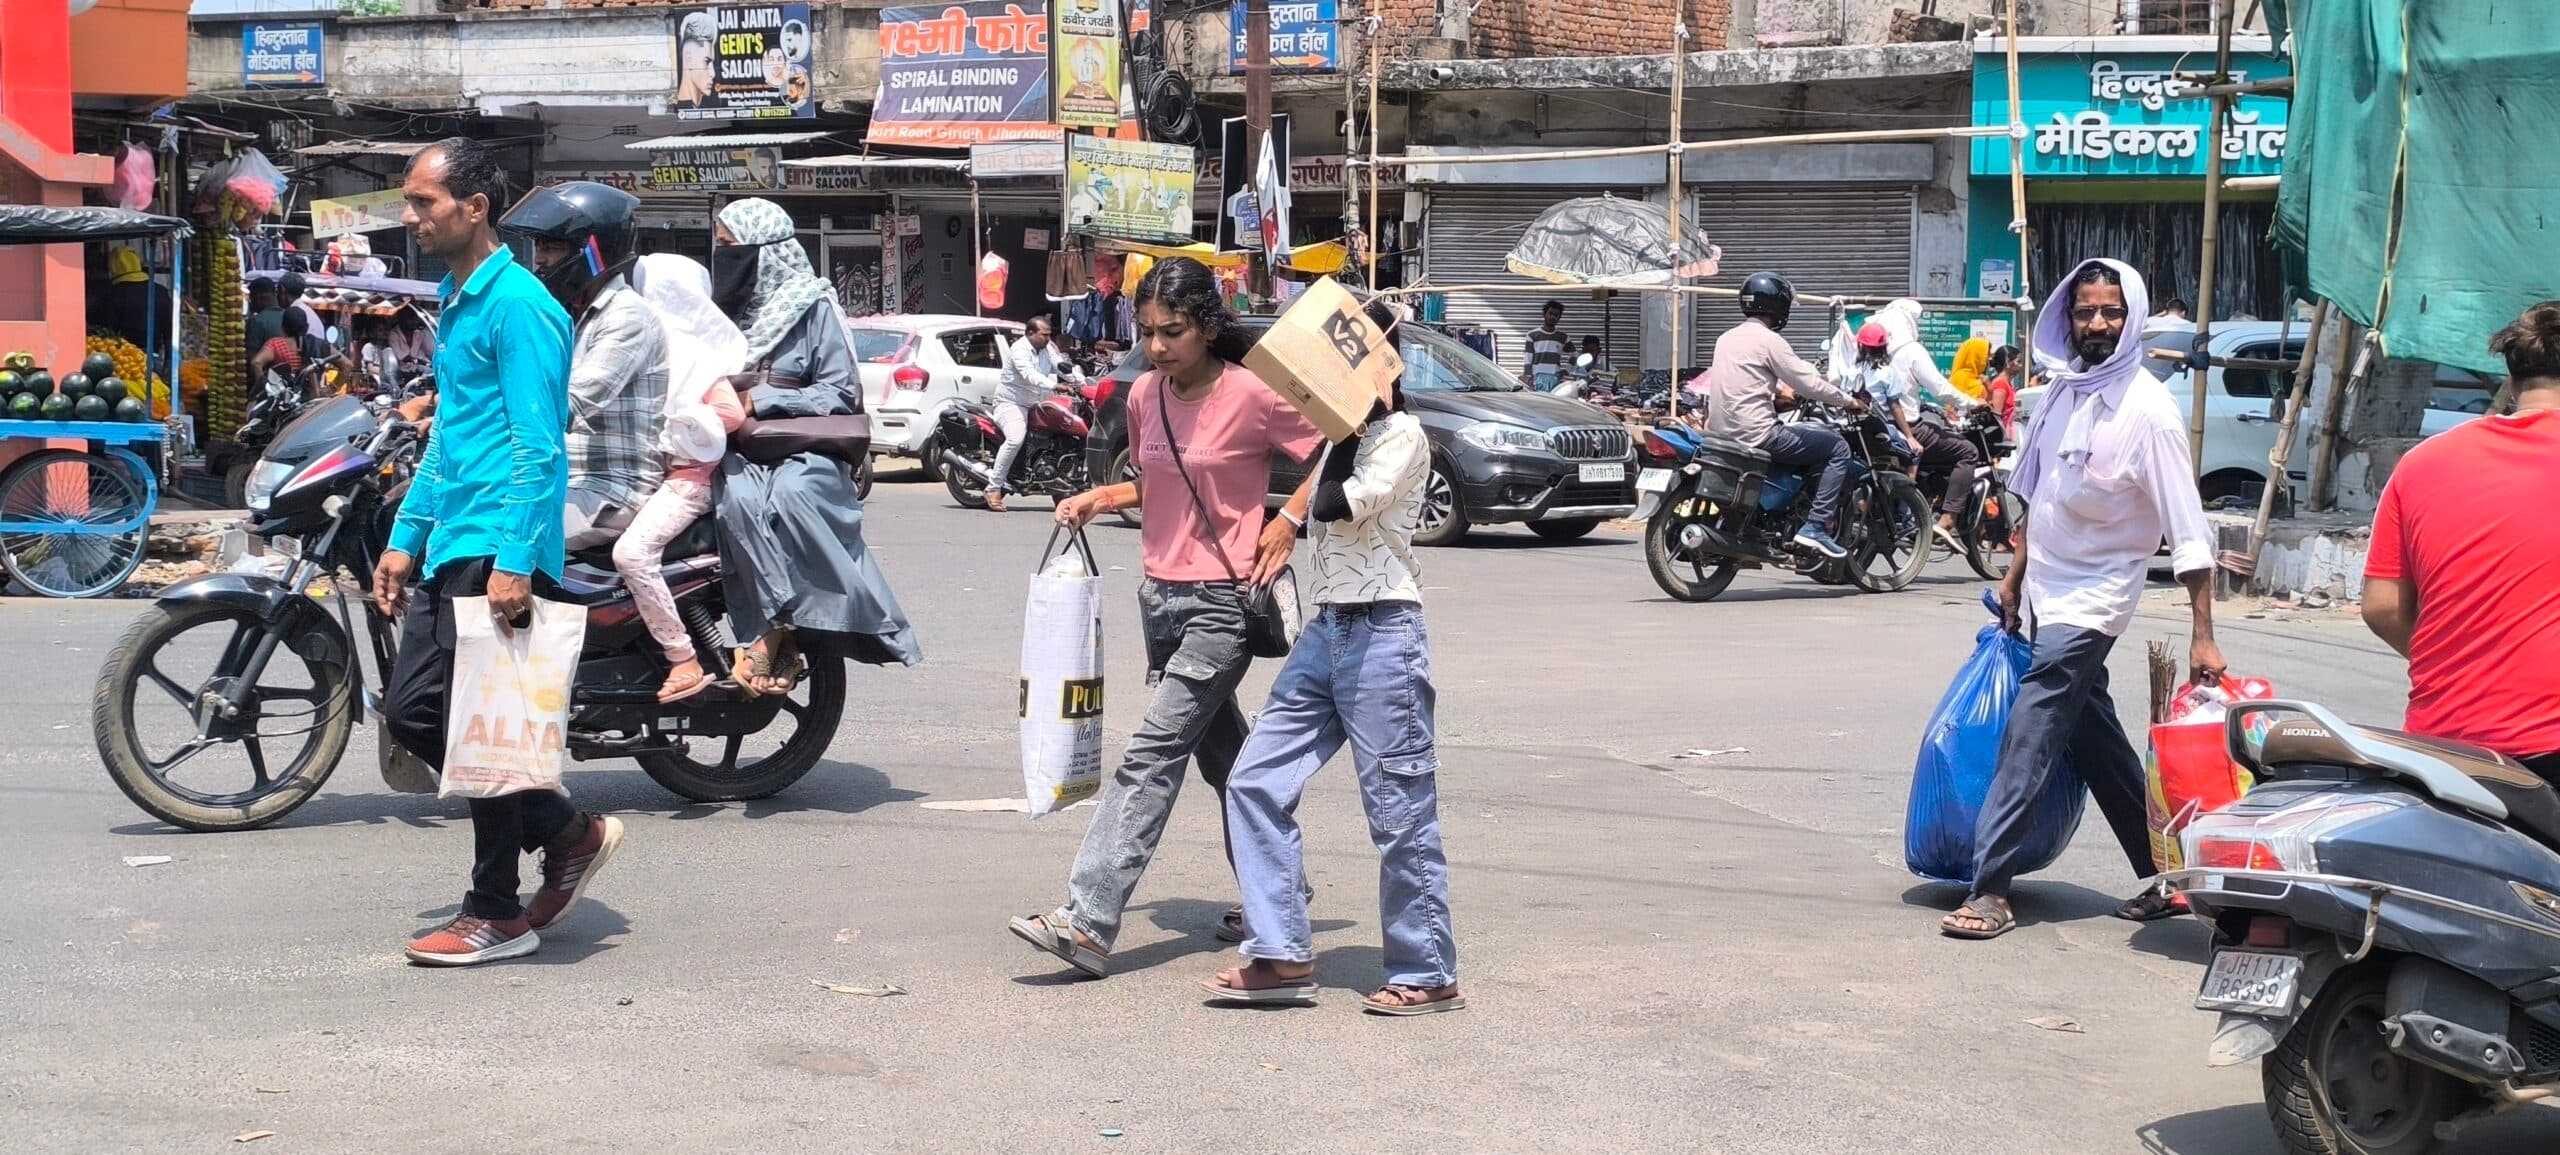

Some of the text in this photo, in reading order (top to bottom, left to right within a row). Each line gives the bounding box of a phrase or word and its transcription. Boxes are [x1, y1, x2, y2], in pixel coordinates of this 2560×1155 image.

[718, 8, 781, 30] JAI JANTA
[1062, 13, 1114, 28] कबीर जयंती
[1269, 3, 1318, 29] दुस्तान
[255, 26, 309, 51] हिन्दुस्तान
[720, 33, 764, 55] GENT'S
[1298, 27, 1329, 51] हॉल
[247, 49, 317, 70] मेडिकल हॉल
[721, 60, 762, 79] SALON
[891, 68, 1018, 88] SPIRAL BINDING
[901, 96, 1002, 114] LAMINATION
[899, 126, 932, 140] Road
[2035, 110, 2202, 158] मेडिकल
[672, 151, 729, 165] JAI JANTA
[653, 166, 697, 184] GENT'S
[699, 166, 733, 183] SALON
[1291, 158, 1342, 184] गणेश
[816, 177, 857, 189] SALOON
[320, 204, 370, 231] A To Z
[463, 714, 563, 753] ALFA
[2281, 727, 2331, 738] HONDA
[2226, 955, 2285, 979] JH11A
[2217, 978, 2279, 1004] R6399
